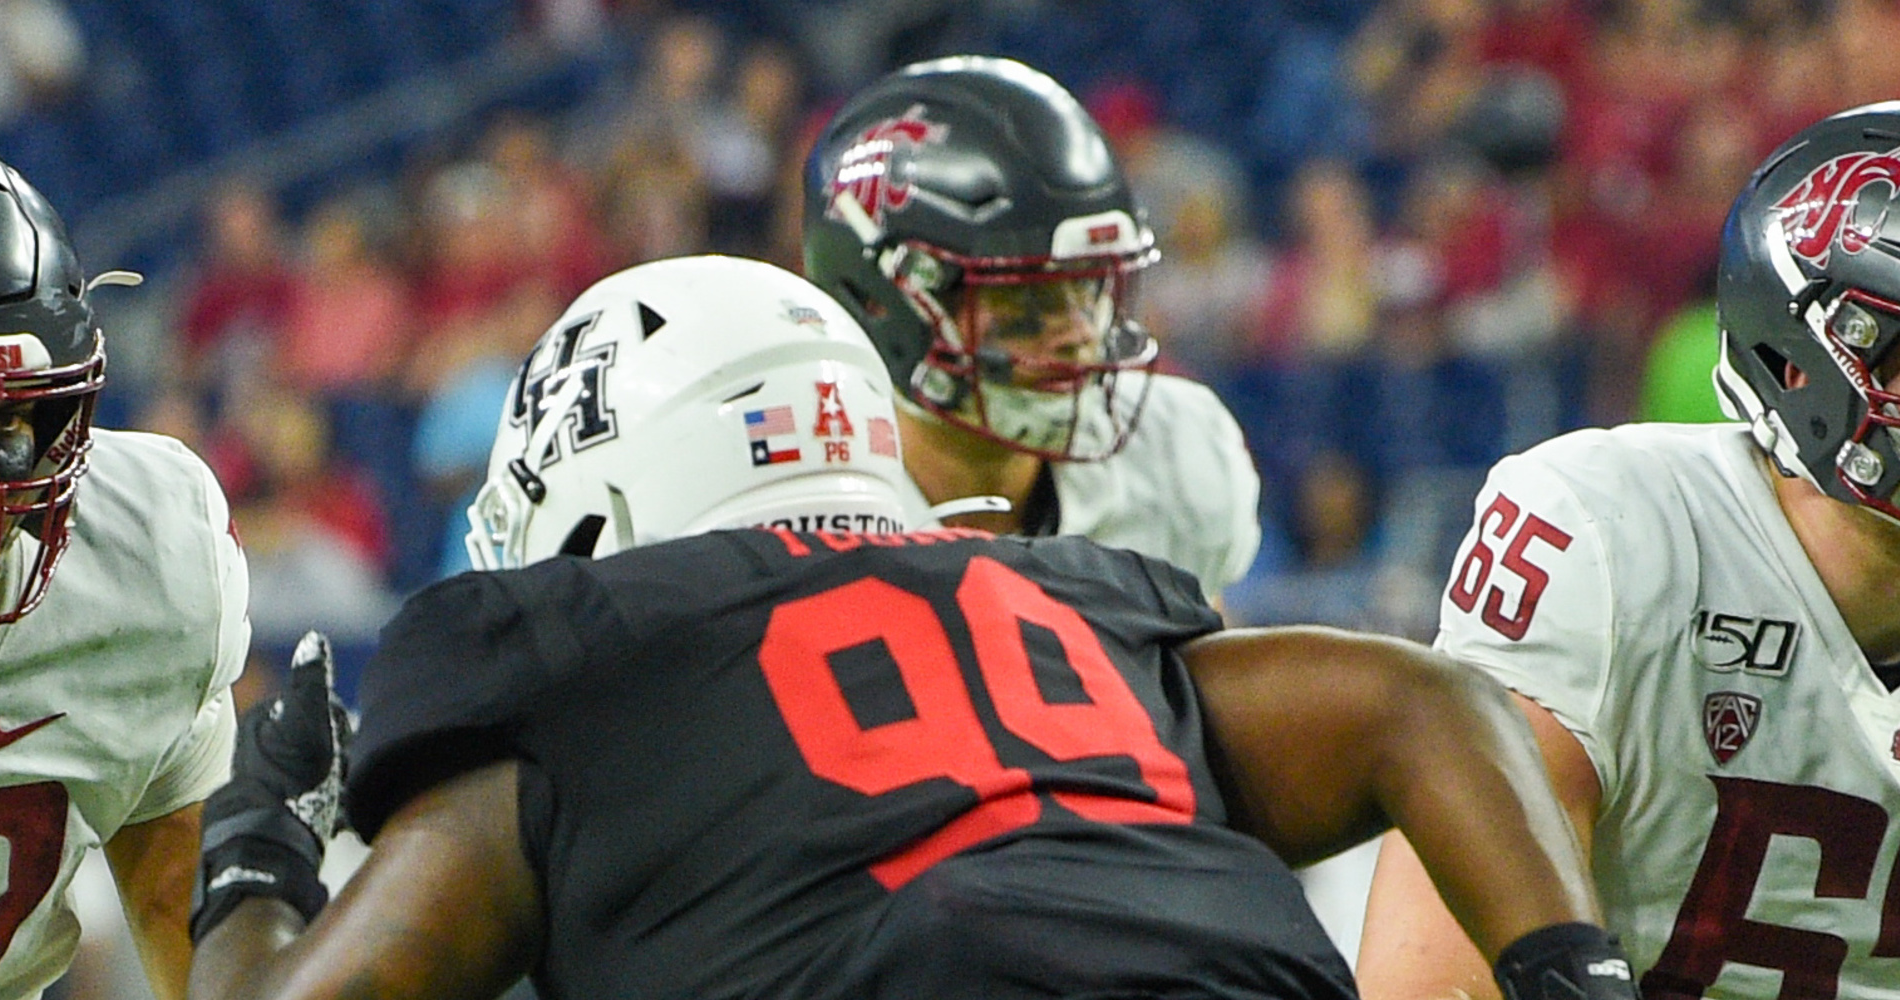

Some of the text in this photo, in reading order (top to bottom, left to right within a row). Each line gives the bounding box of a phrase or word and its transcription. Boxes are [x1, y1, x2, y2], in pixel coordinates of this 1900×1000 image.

[824, 441, 850, 463] P6
[1449, 491, 1574, 641] 65
[1698, 611, 1797, 668] 150
[757, 556, 1196, 892] 99
[1706, 696, 1757, 737] PAC
[1715, 723, 1740, 750] 12
